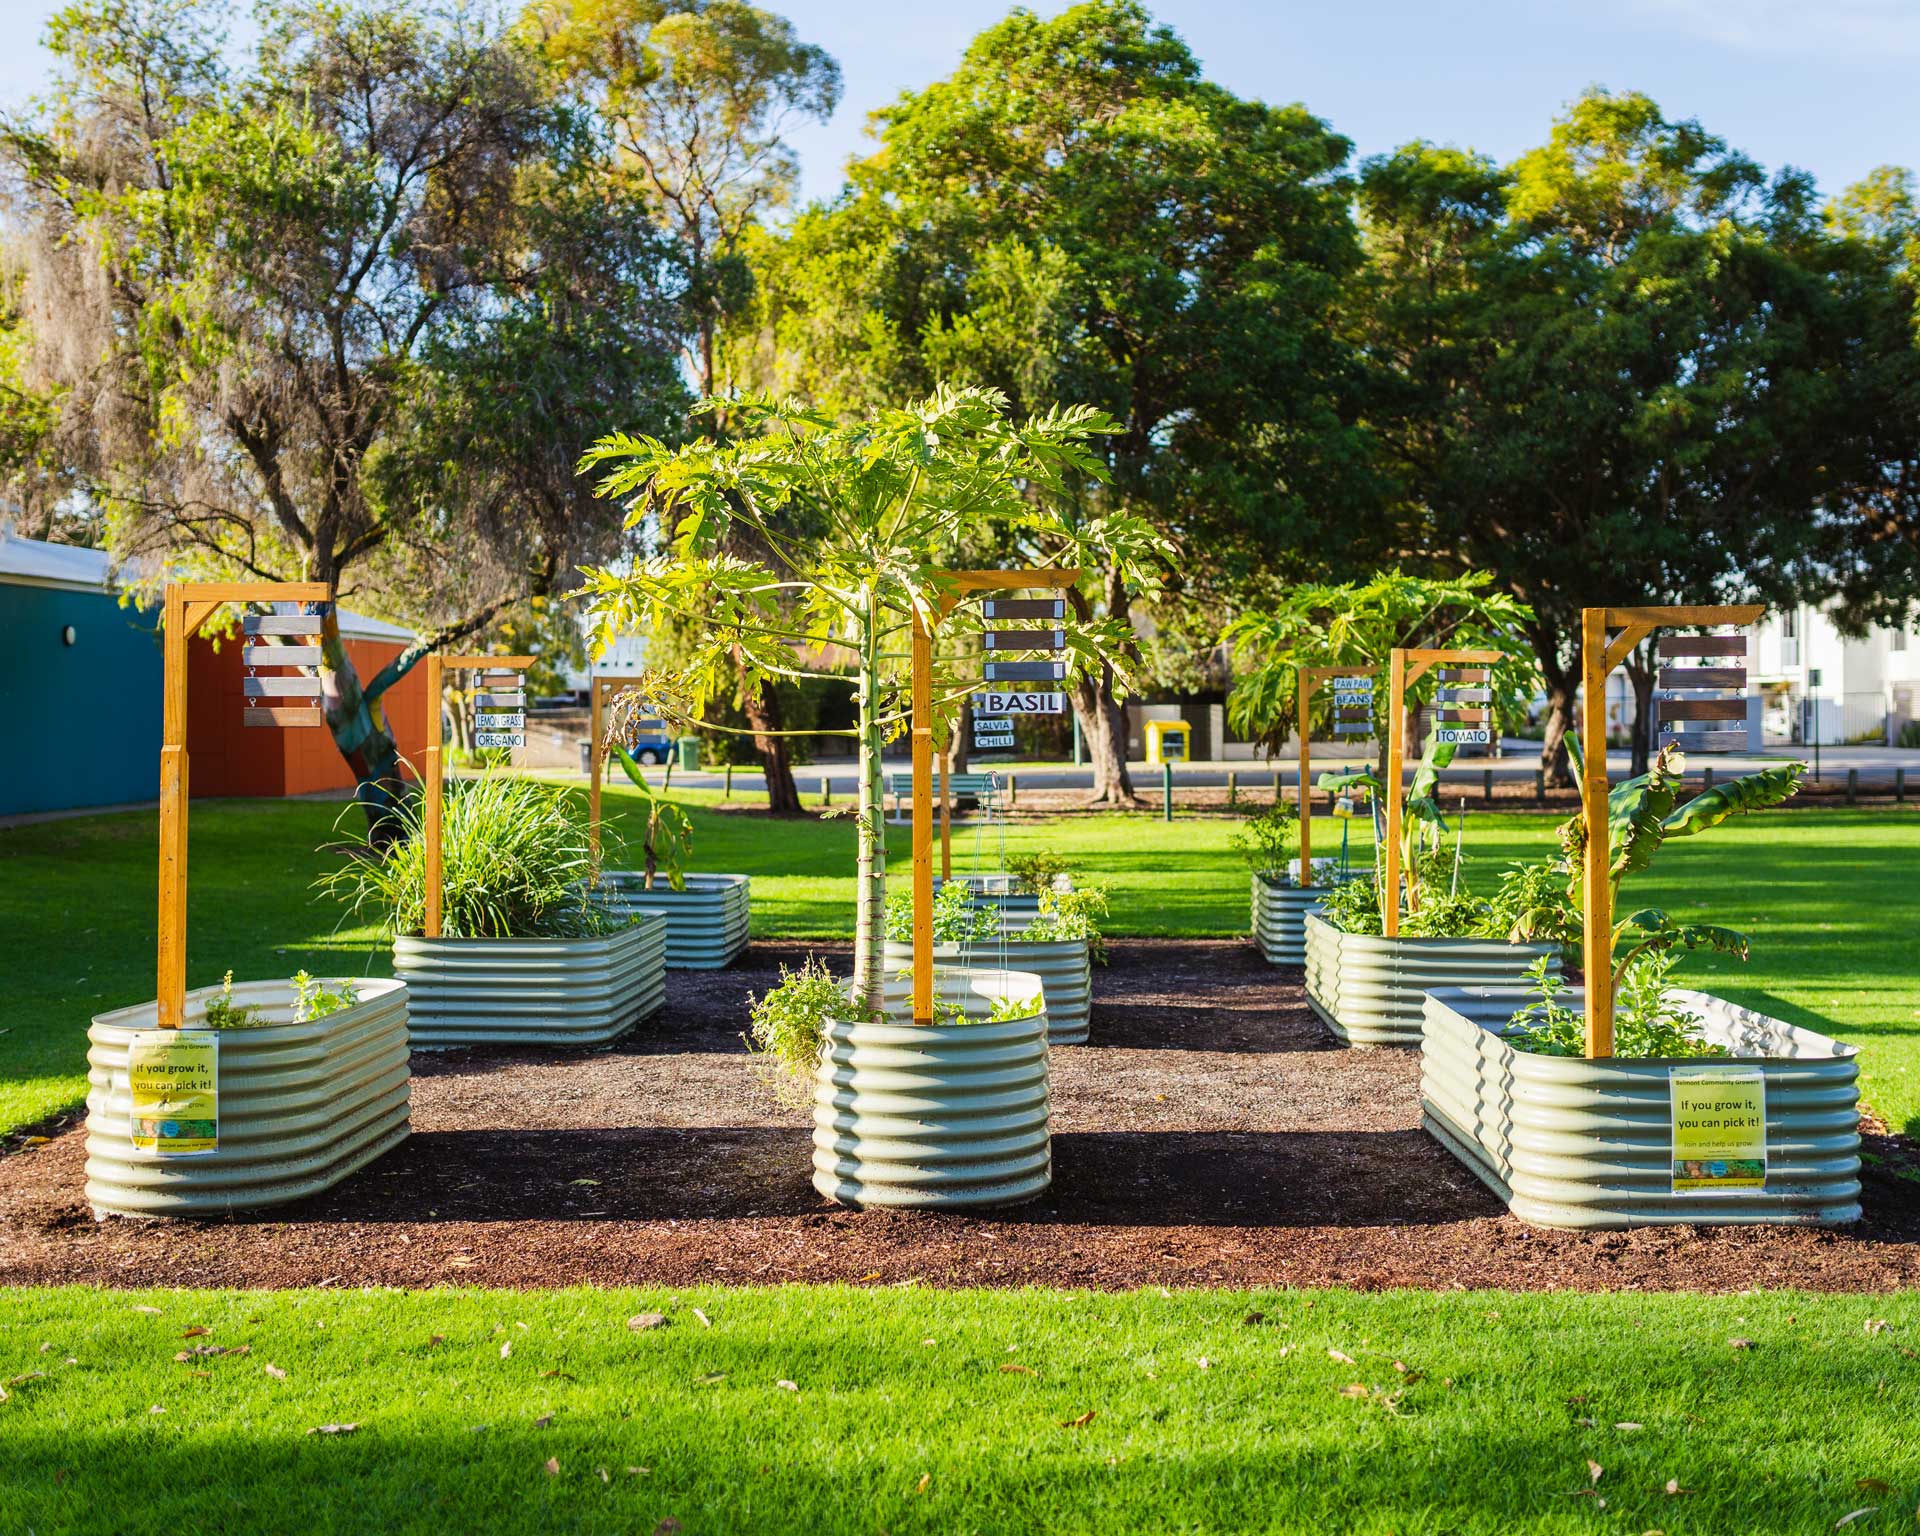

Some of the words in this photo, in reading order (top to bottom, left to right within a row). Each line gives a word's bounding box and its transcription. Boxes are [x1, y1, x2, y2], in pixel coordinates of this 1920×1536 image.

[1336, 679, 1352, 688] PAW
[1354, 679, 1370, 688] PAW
[989, 694, 1059, 711] BASIL
[1336, 695, 1370, 704] BEANS
[477, 715, 500, 727] LEMON
[501, 715, 521, 727] GRASS
[976, 721, 1010, 730] SALVIA
[478, 734, 522, 746] OREGANO
[978, 737, 1012, 746] CHILLI
[1441, 730, 1487, 742] TOMATO
[136, 1063, 144, 1073] If
[146, 1065, 165, 1075] you
[168, 1064, 195, 1075] grow
[197, 1063, 208, 1074] it,
[134, 1081, 153, 1091] you
[155, 1082, 173, 1090] can
[176, 1080, 197, 1091] pick
[199, 1080, 212, 1090] it!
[1681, 1100, 1689, 1110] If
[1691, 1102, 1712, 1112] you
[1714, 1101, 1742, 1112] grow
[1745, 1099, 1756, 1110] it,
[1678, 1120, 1698, 1130] you
[1701, 1119, 1720, 1128] can
[1723, 1117, 1745, 1129] pick
[1747, 1117, 1760, 1127] it!
